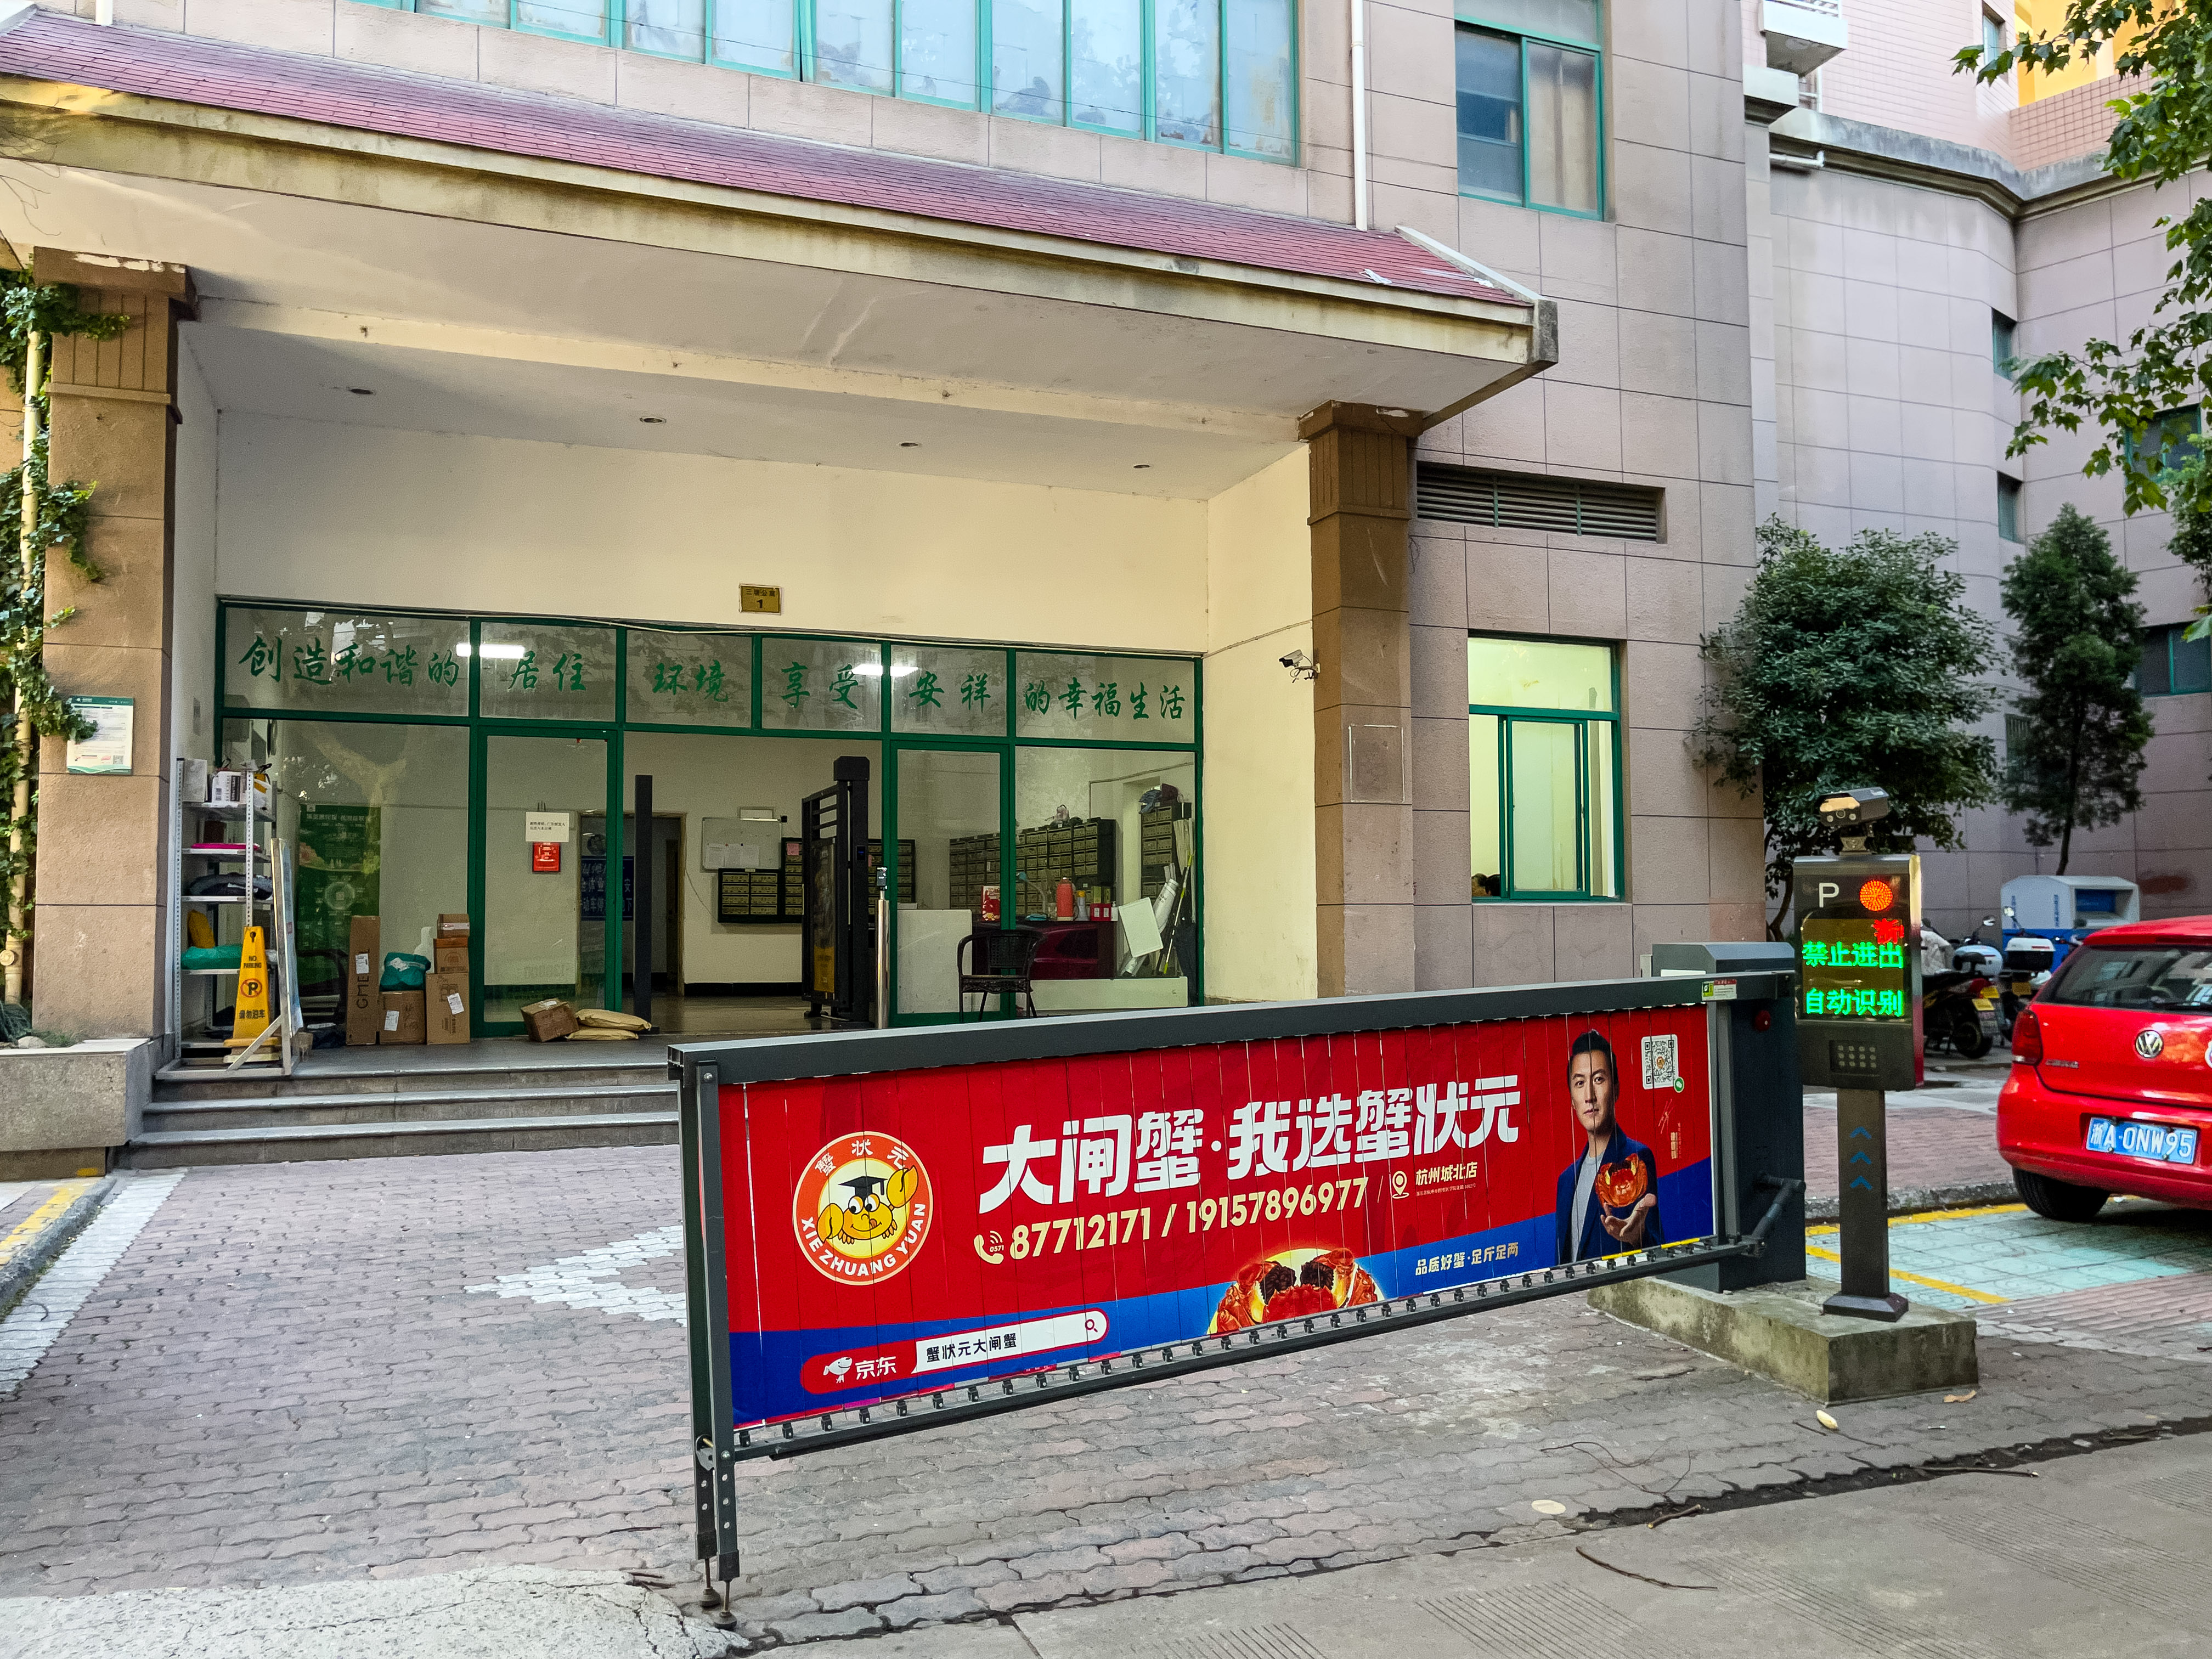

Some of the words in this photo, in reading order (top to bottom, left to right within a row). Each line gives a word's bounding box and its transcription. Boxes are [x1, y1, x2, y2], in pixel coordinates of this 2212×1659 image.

[757, 599, 763, 609] 1
[508, 651, 586, 692] 居住
[652, 660, 729, 703] 环境
[781, 662, 859, 709] 享受
[909, 671, 992, 713] 安祥
[1024, 677, 1186, 720] 的幸福生活
[1819, 882, 1839, 909] P
[1802, 941, 1904, 969] 禁止进出
[1805, 988, 1904, 1018] 自动识别
[815, 1139, 909, 1176] 蟹状元
[1415, 1162, 1478, 1186] 杭州城北店
[1009, 1207, 1150, 1260] 87712171
[1187, 1176, 1368, 1233] 19157896977
[801, 1217, 823, 1252] XIE
[819, 1249, 896, 1277] ZHUANG
[895, 1203, 926, 1255] YUAN
[926, 1333, 1017, 1362] 蟹状元大闸蟹
[855, 1356, 896, 1380] 京东
